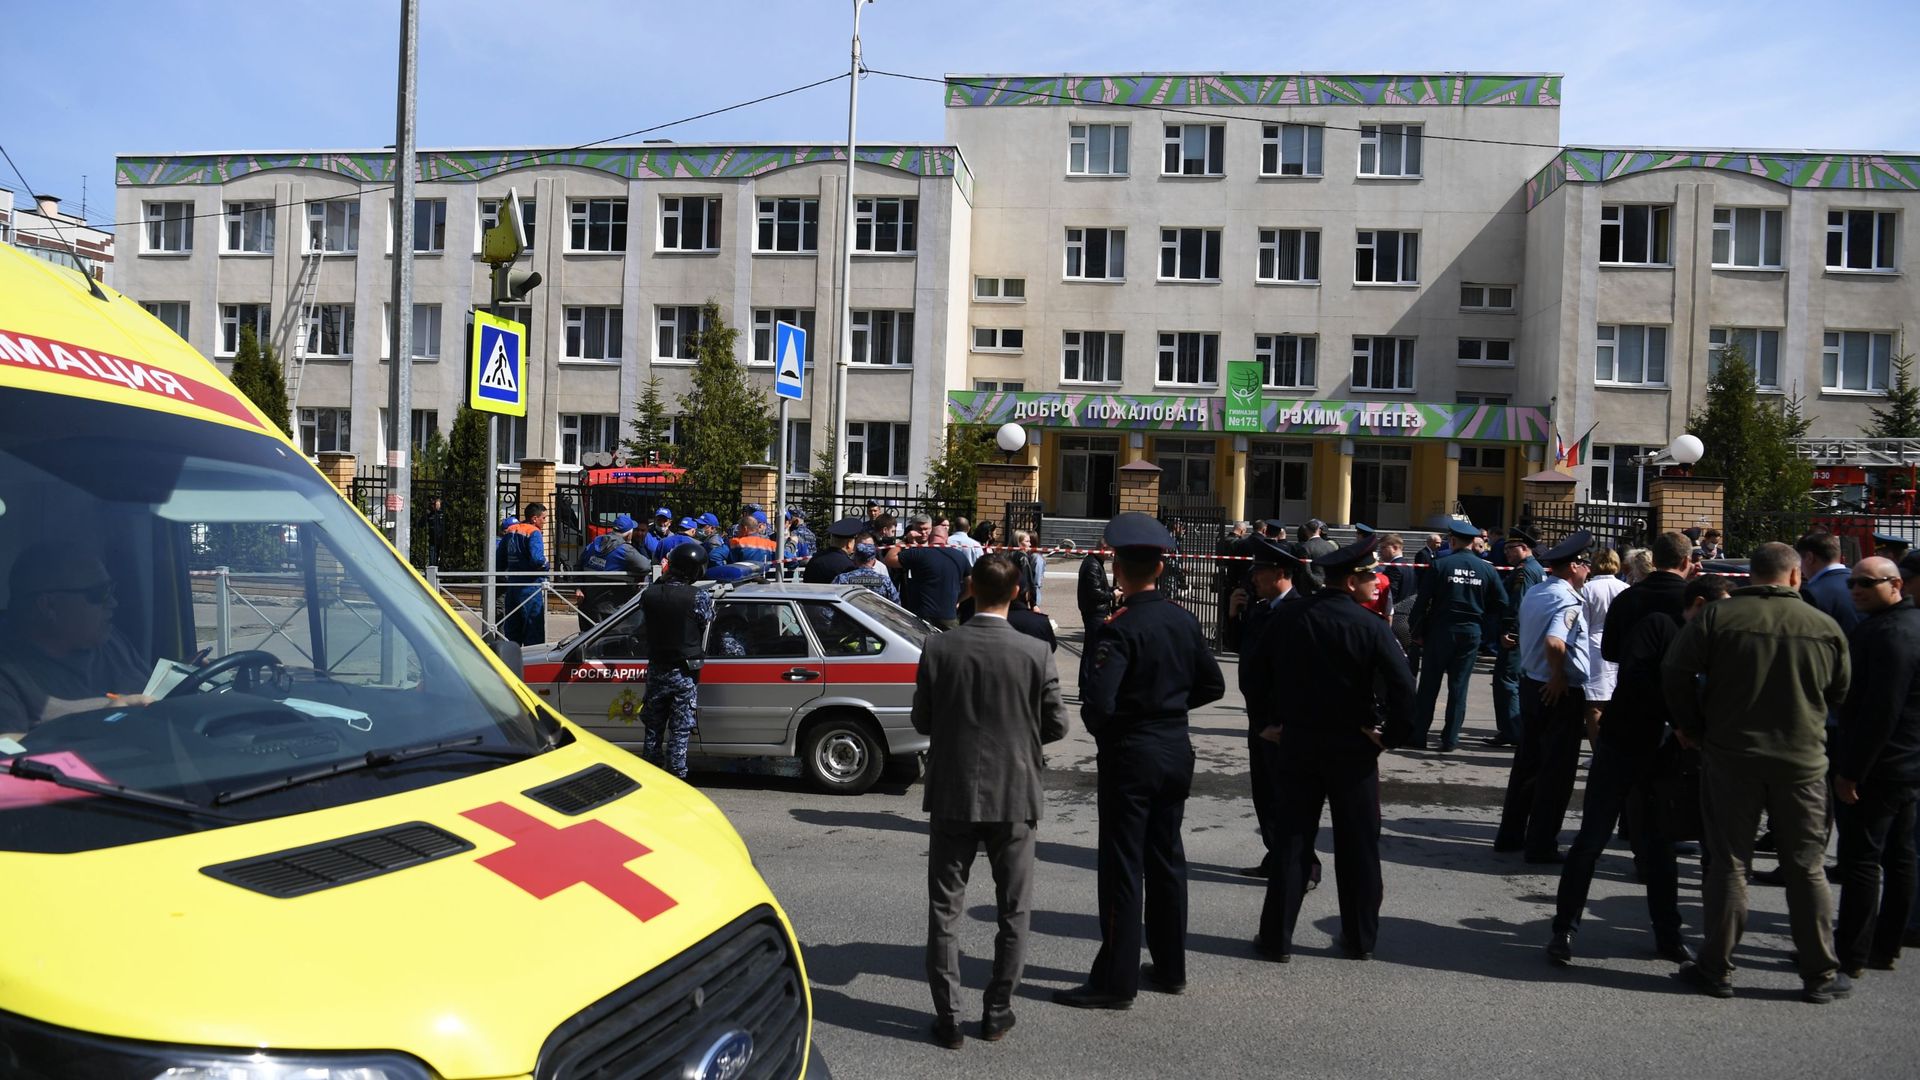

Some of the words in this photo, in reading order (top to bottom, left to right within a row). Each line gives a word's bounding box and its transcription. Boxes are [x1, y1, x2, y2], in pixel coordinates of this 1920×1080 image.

[0, 333, 194, 400] МАЦИЯ
[1014, 401, 1071, 419] ДОБРО
[1087, 404, 1208, 422] ПОЖАЛОВАТЬ
[1228, 416, 1258, 427] №175
[1360, 410, 1422, 427] ИТЕГЕЗ
[1454, 569, 1476, 577] МЧС
[1447, 576, 1482, 585] РОССИИ
[570, 668, 648, 680] РОСГВАРДИ
